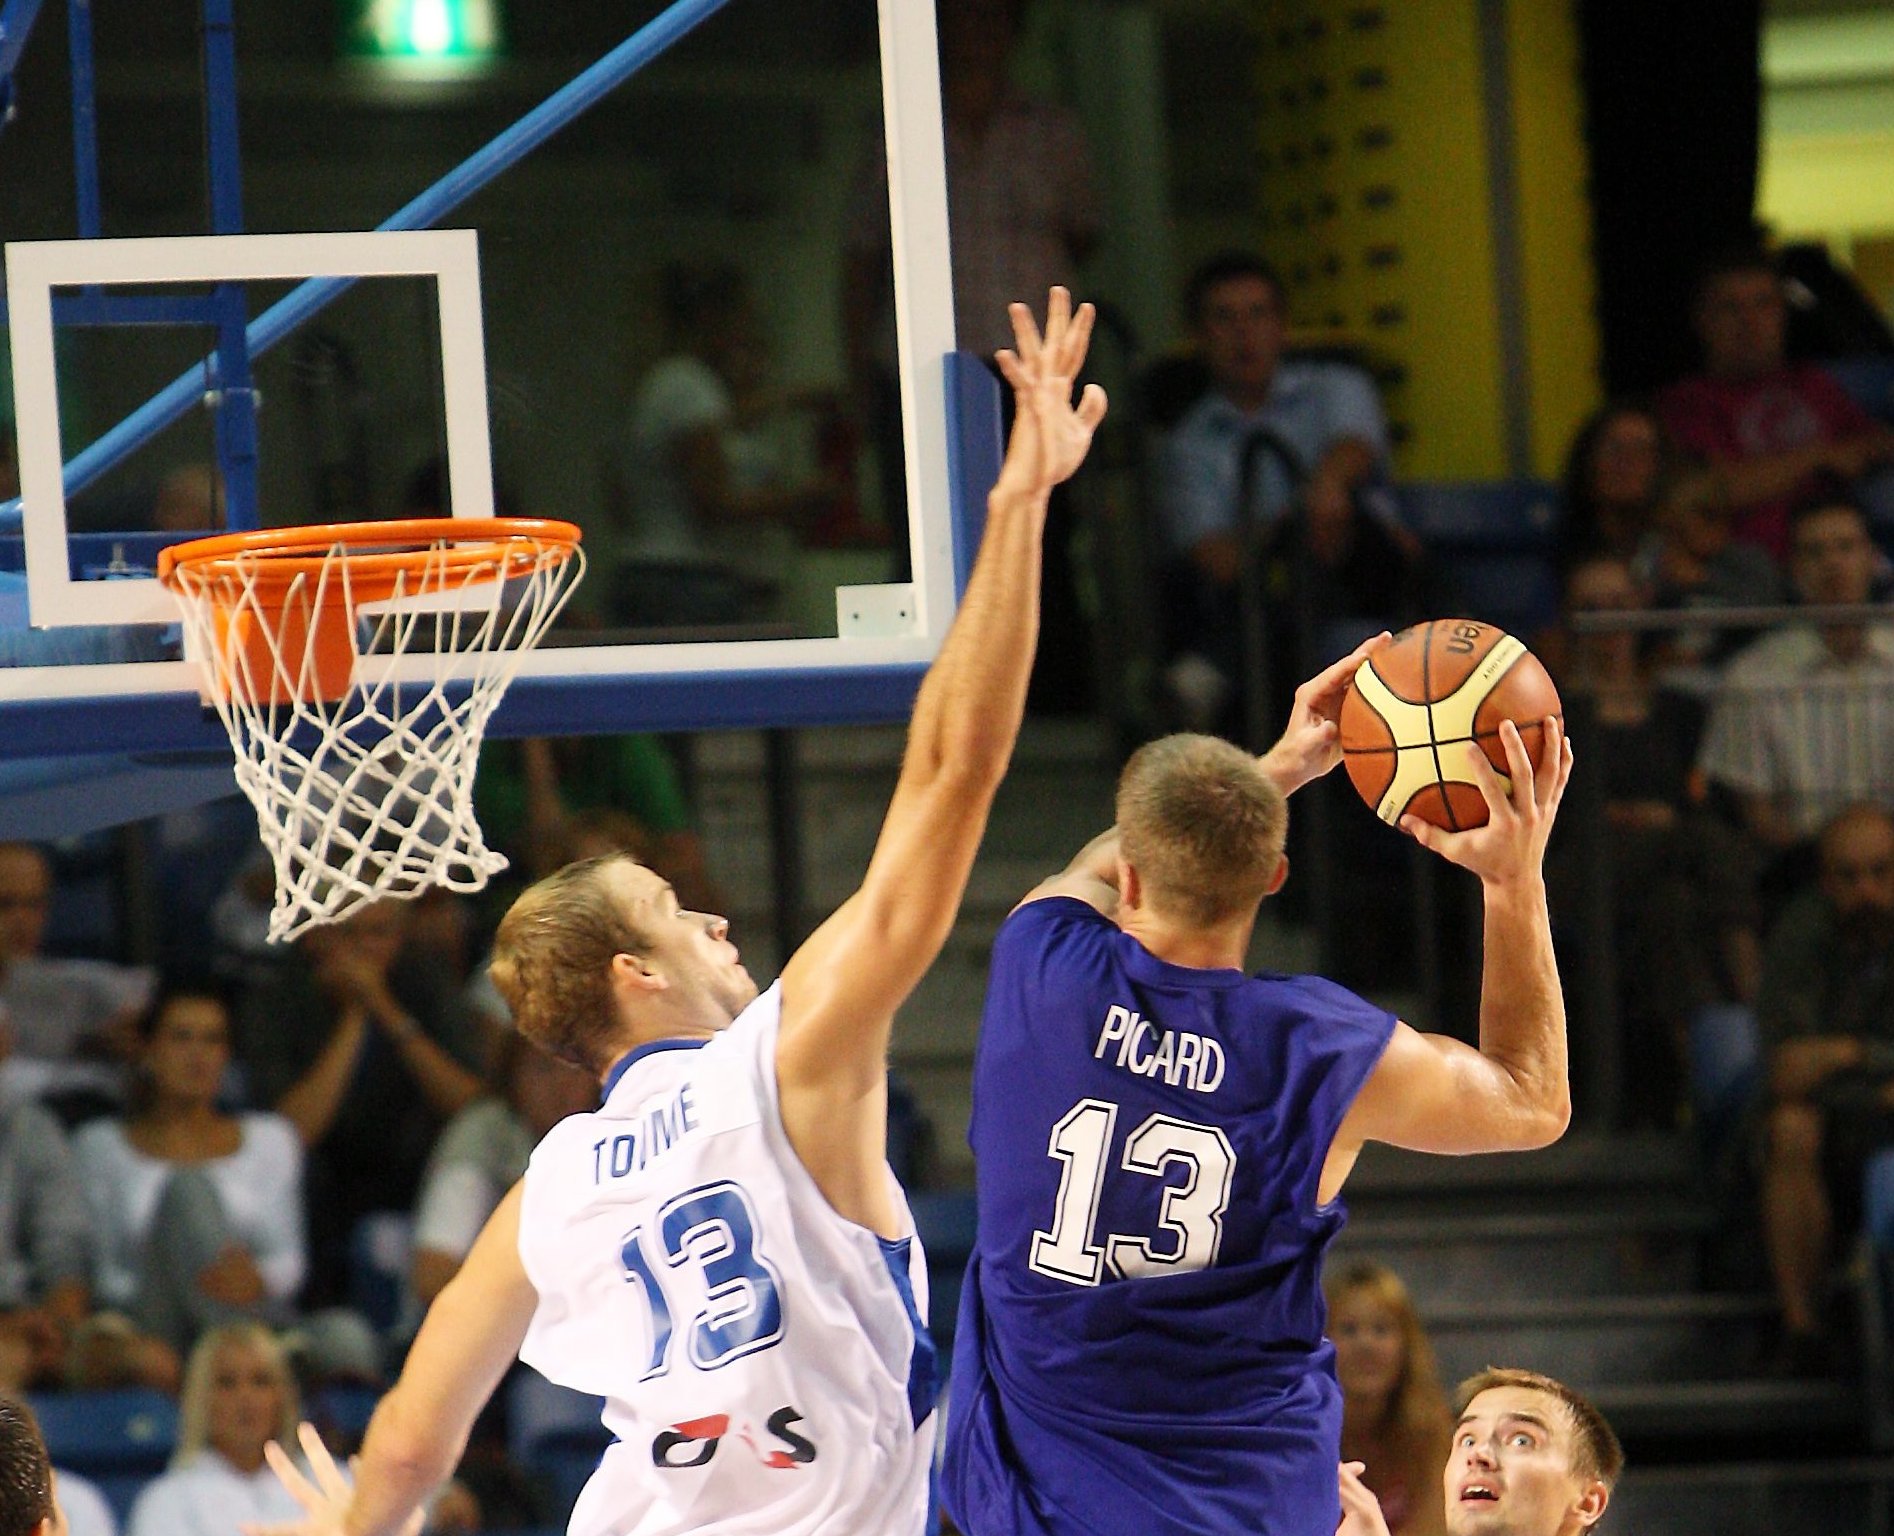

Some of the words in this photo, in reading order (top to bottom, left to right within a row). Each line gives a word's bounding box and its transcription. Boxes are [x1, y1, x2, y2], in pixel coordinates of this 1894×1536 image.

[1094, 1004, 1226, 1093] PICARD
[619, 1179, 786, 1383] 13
[1028, 1098, 1238, 1288] 13
